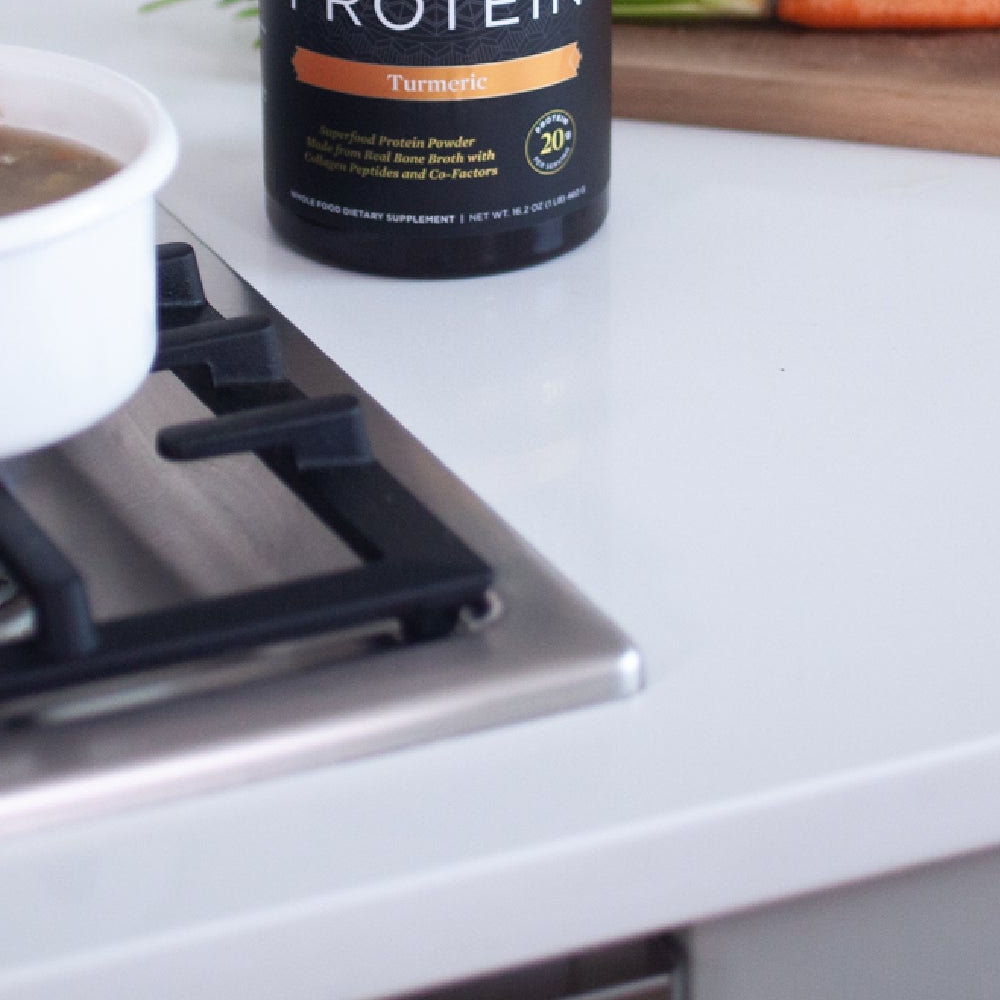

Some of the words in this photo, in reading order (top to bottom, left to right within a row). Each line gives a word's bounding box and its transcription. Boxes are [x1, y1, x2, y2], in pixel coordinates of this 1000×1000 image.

[387, 73, 487, 93] Turmeric
[379, 136, 425, 149] Protein
[428, 136, 477, 149] Powder
[364, 150, 392, 163] Real
[394, 152, 425, 164] Bone
[428, 152, 464, 164] Broth
[467, 149, 496, 163] with
[349, 162, 400, 179] Peptides
[401, 168, 427, 179] and
[429, 168, 499, 180] Co-Factors
[316, 200, 341, 214] FOOD
[342, 206, 384, 220] DIETARY
[386, 213, 455, 225] SUPPLEMENT
[468, 211, 489, 222] NET
